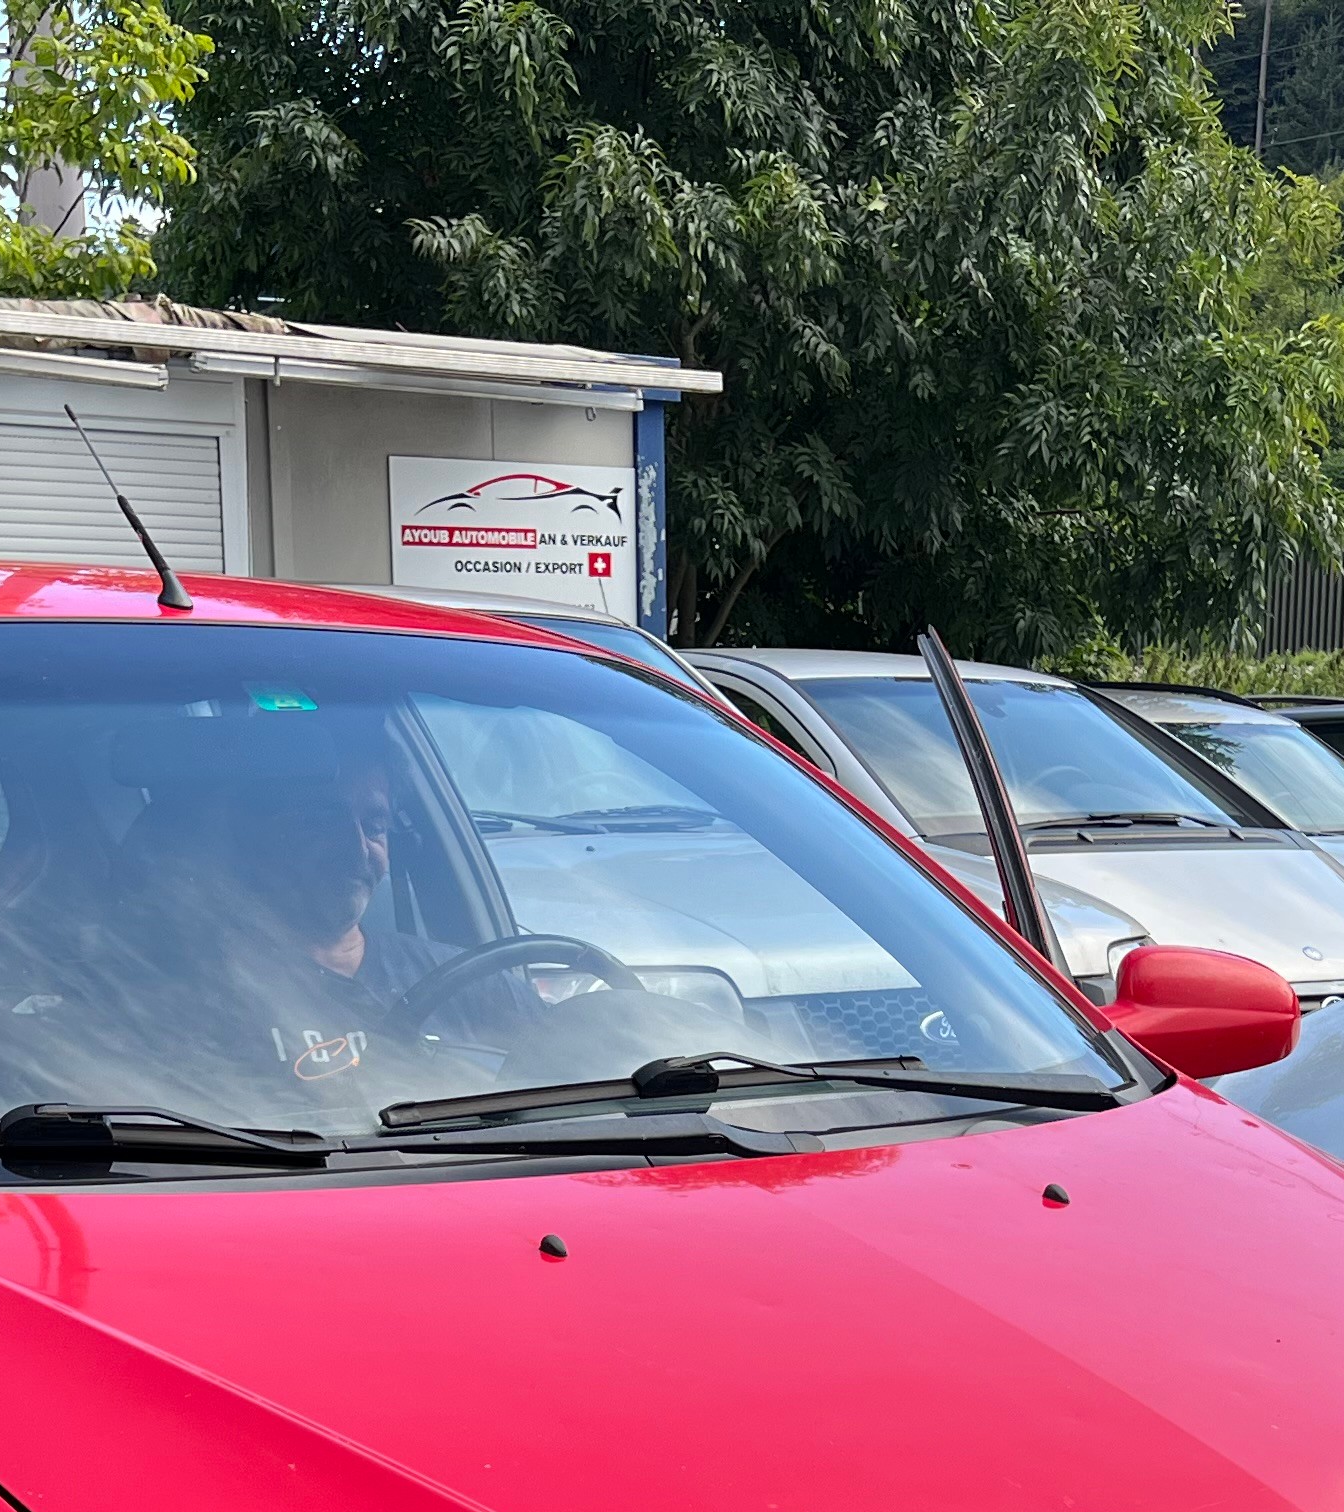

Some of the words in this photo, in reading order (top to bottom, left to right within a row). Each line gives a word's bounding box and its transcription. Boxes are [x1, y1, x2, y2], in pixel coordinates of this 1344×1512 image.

[403, 529, 450, 543] AYOUB
[452, 530, 536, 546] AUTOMOBILE
[539, 533, 557, 545] AN
[560, 534, 568, 546] &
[572, 534, 627, 547] VERKAUF
[455, 560, 522, 573] OCCASION
[535, 562, 584, 574] EXPORT
